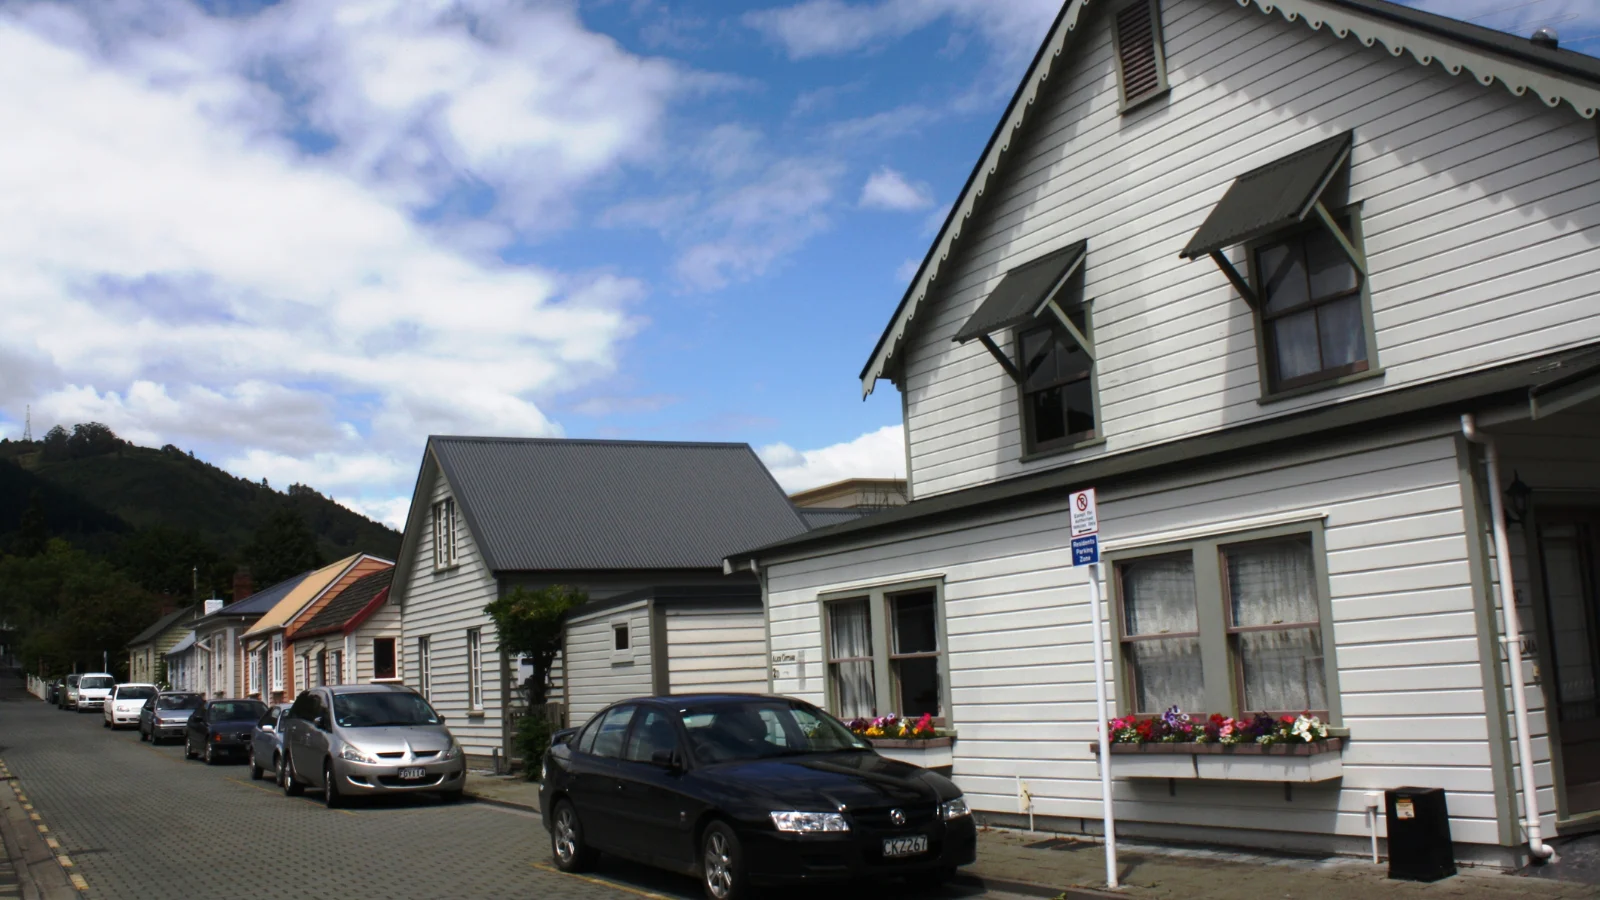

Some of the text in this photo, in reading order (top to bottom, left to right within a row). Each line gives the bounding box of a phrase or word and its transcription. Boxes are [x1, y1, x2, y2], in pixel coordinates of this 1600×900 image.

[1073, 539, 1095, 547] Residents
[1076, 547, 1093, 555] Parking
[883, 836, 927, 855] CKZ267
